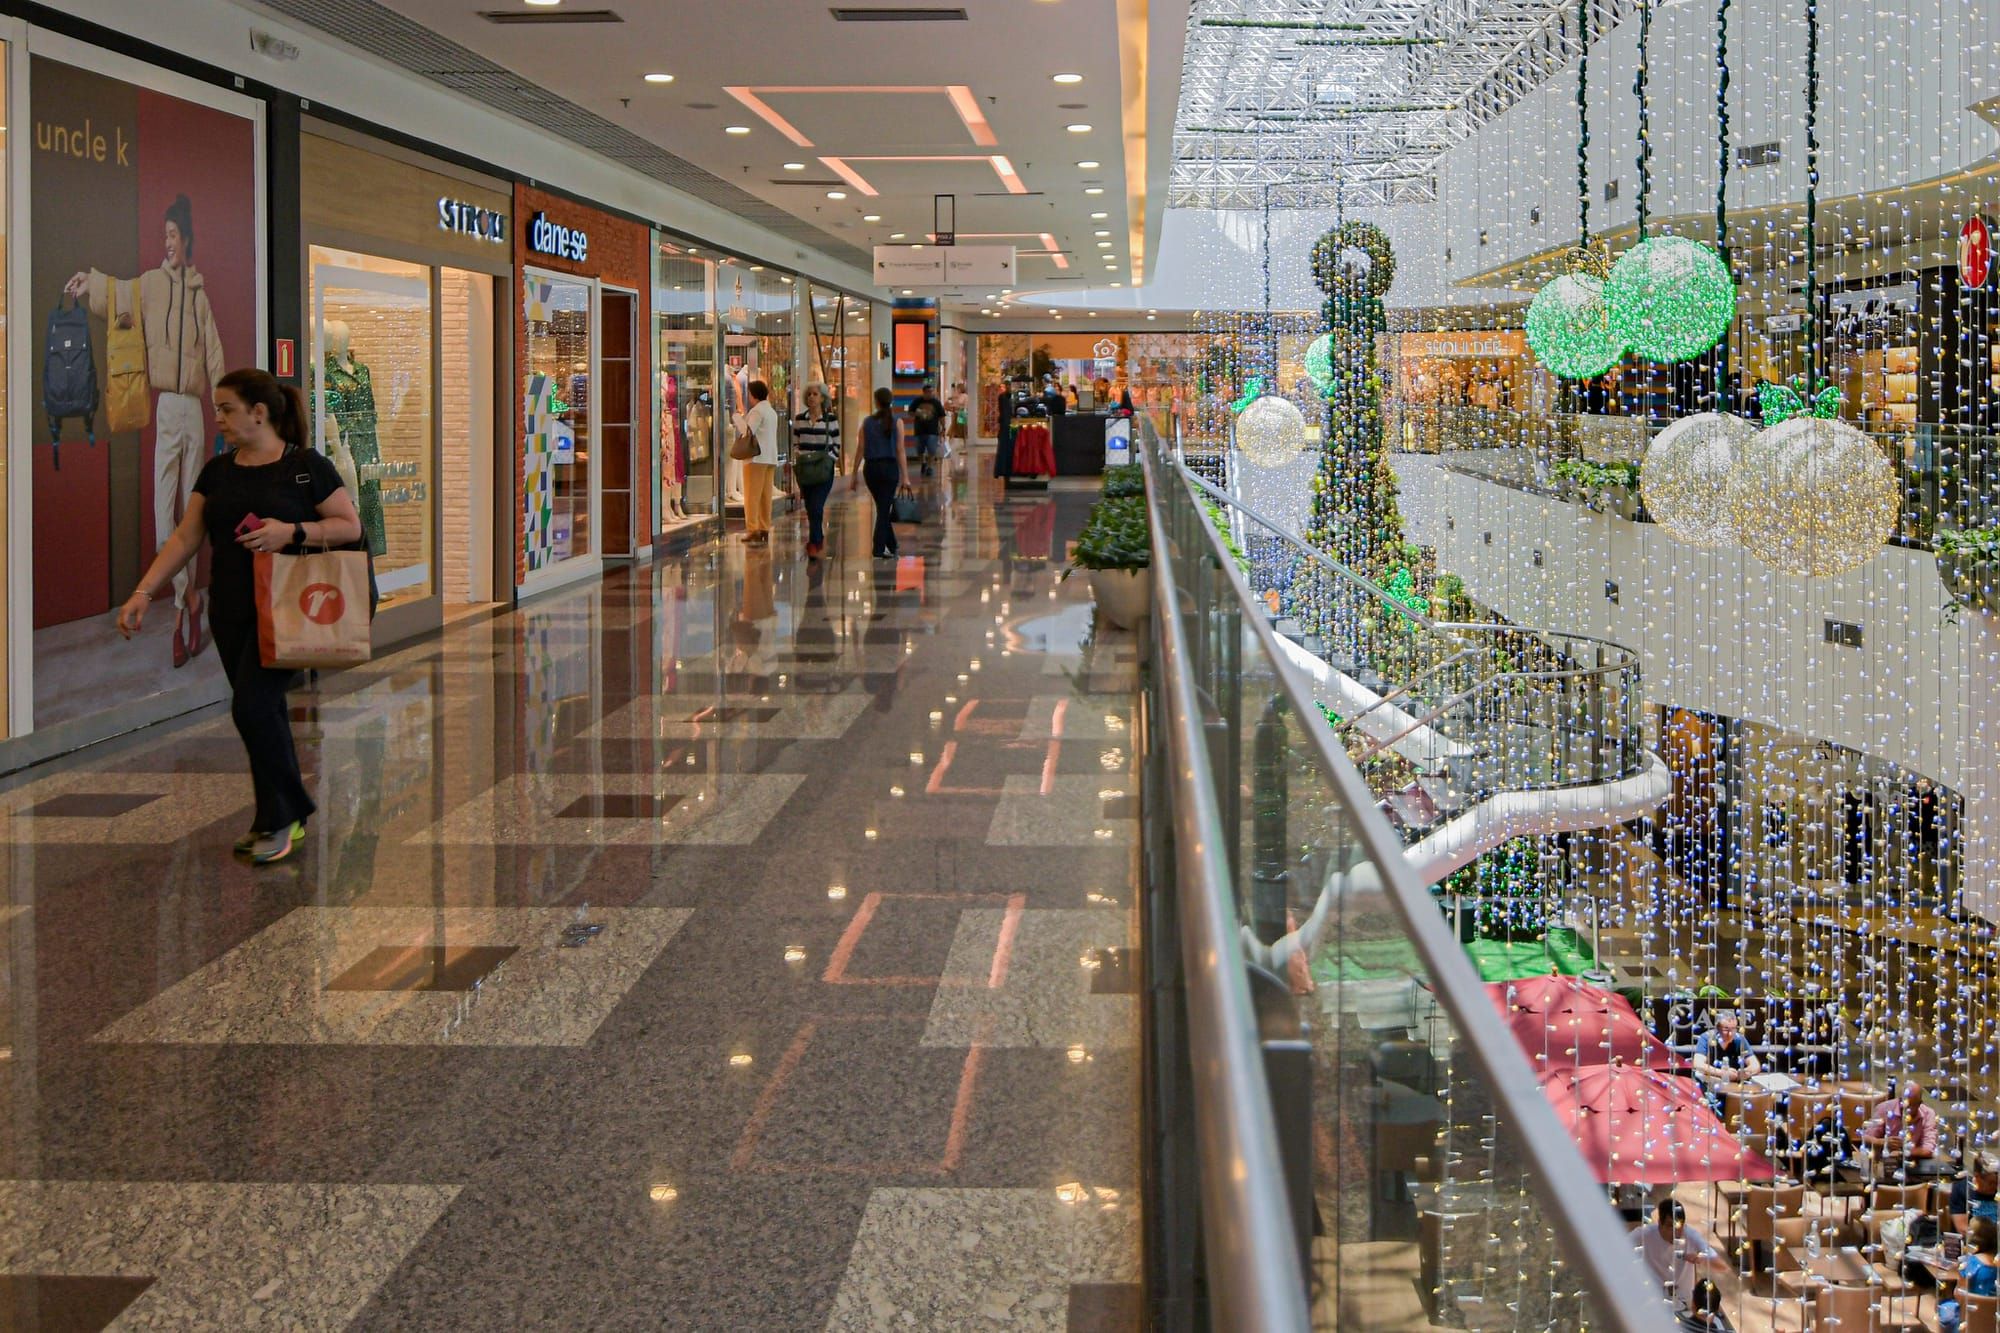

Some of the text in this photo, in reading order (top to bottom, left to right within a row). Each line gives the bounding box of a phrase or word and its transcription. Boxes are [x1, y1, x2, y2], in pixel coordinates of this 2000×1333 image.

[37, 119, 129, 167] uncle k
[1667, 1003, 1757, 1030] CAE
